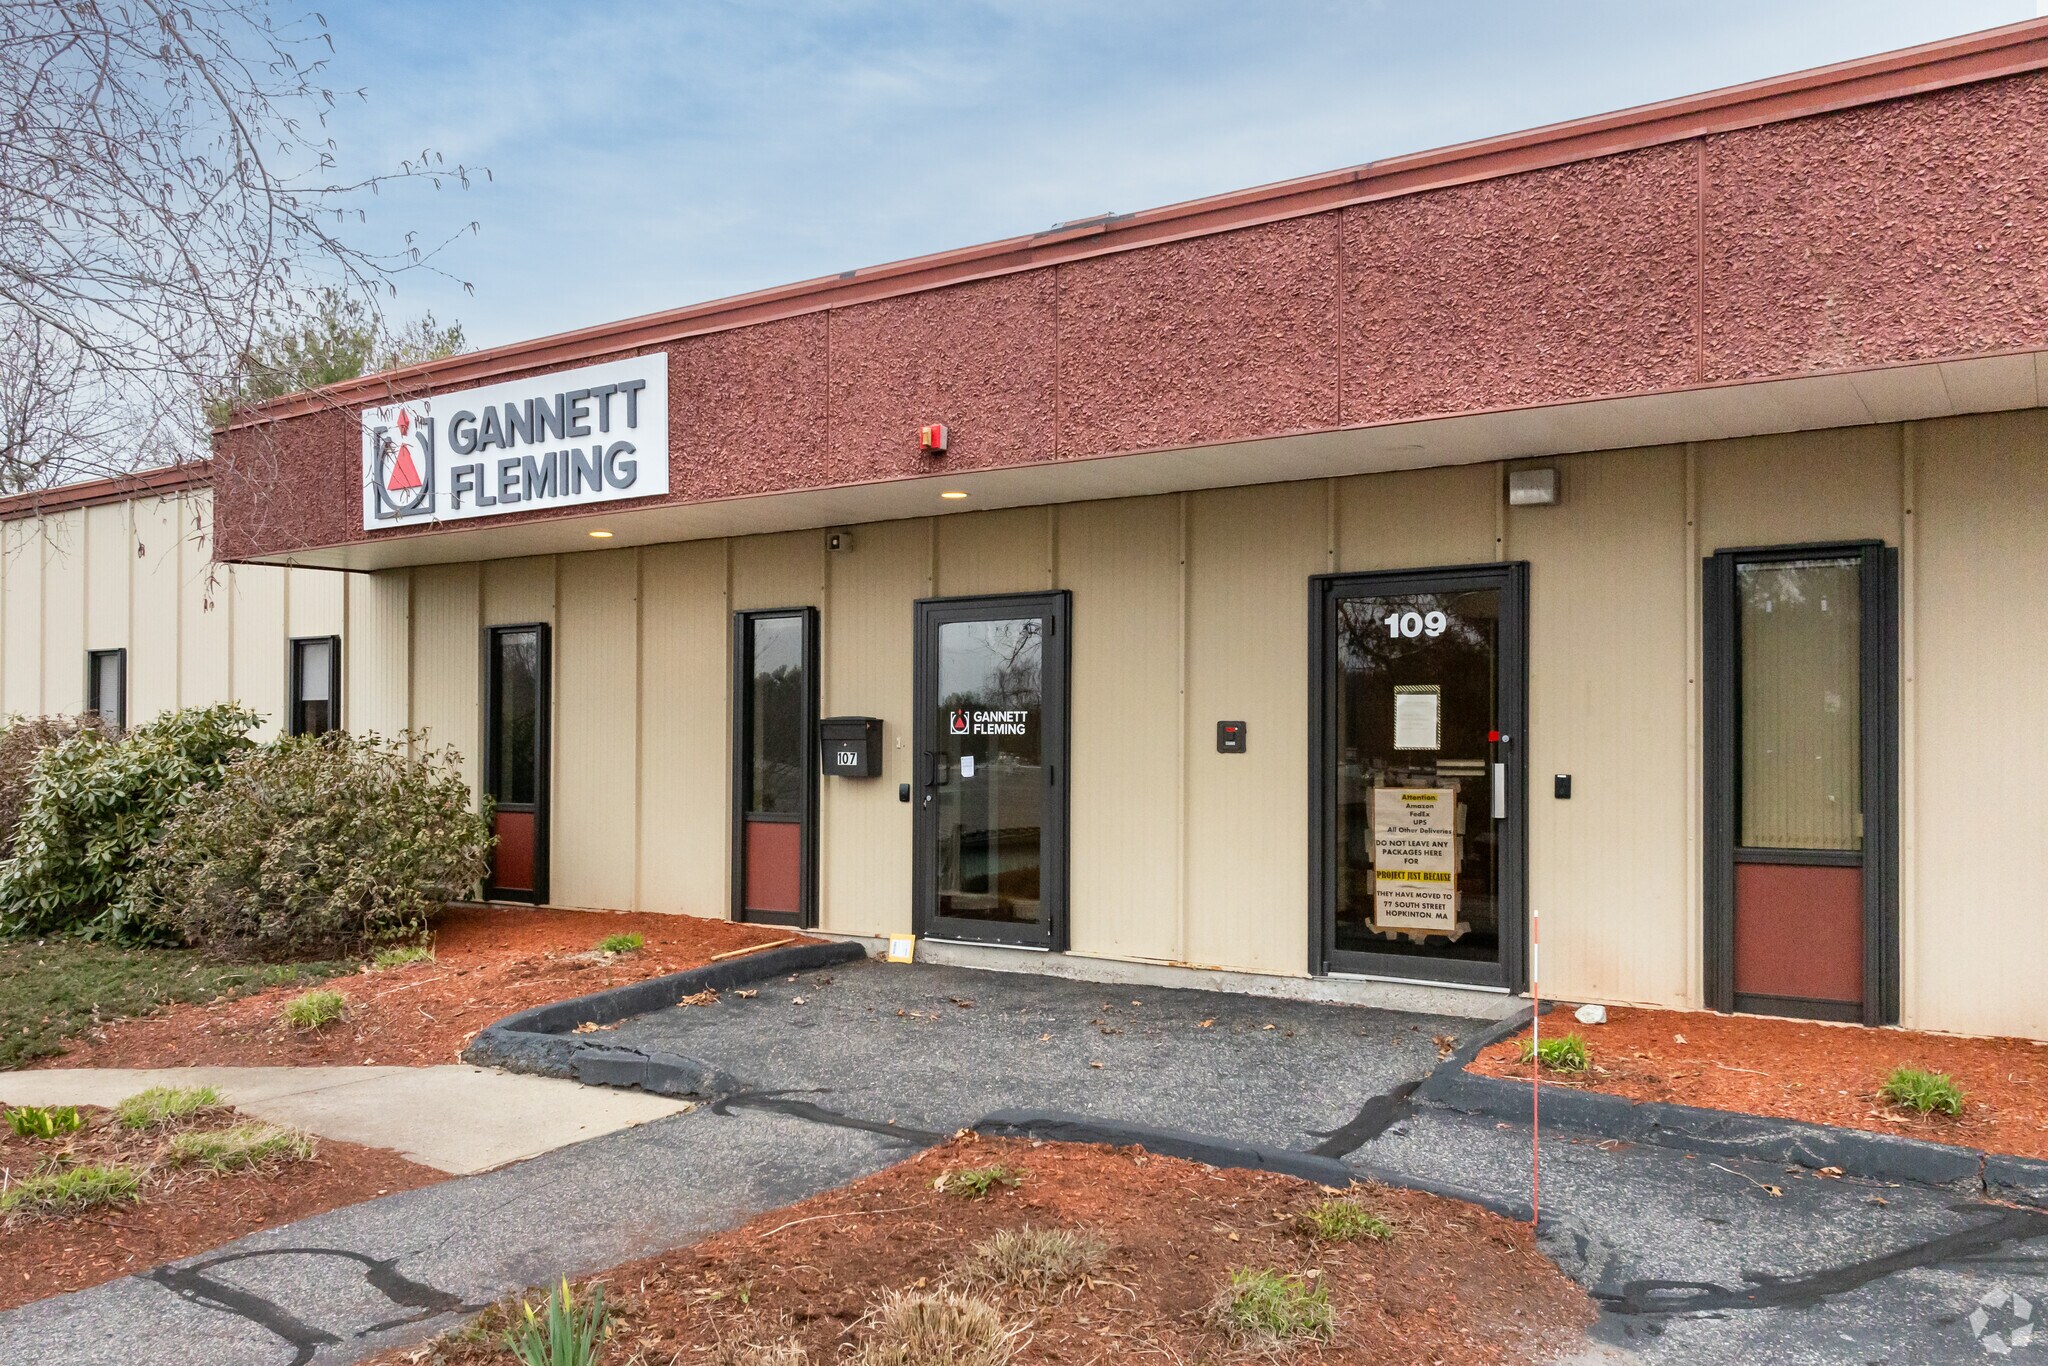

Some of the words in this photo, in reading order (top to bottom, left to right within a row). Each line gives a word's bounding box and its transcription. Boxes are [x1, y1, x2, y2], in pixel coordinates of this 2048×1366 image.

[448, 379, 646, 455] GANNETT
[450, 440, 637, 510] FLEMING
[1384, 611, 1447, 638] 109
[973, 711, 1028, 723] GANNETT
[973, 723, 1026, 735] FLEMING
[838, 752, 857, 765] 107
[1376, 871, 1406, 880] PROJECT
[1407, 872, 1421, 881] JUST
[1423, 872, 1451, 881] BECAUSE
[1395, 901, 1420, 909] SOUTH
